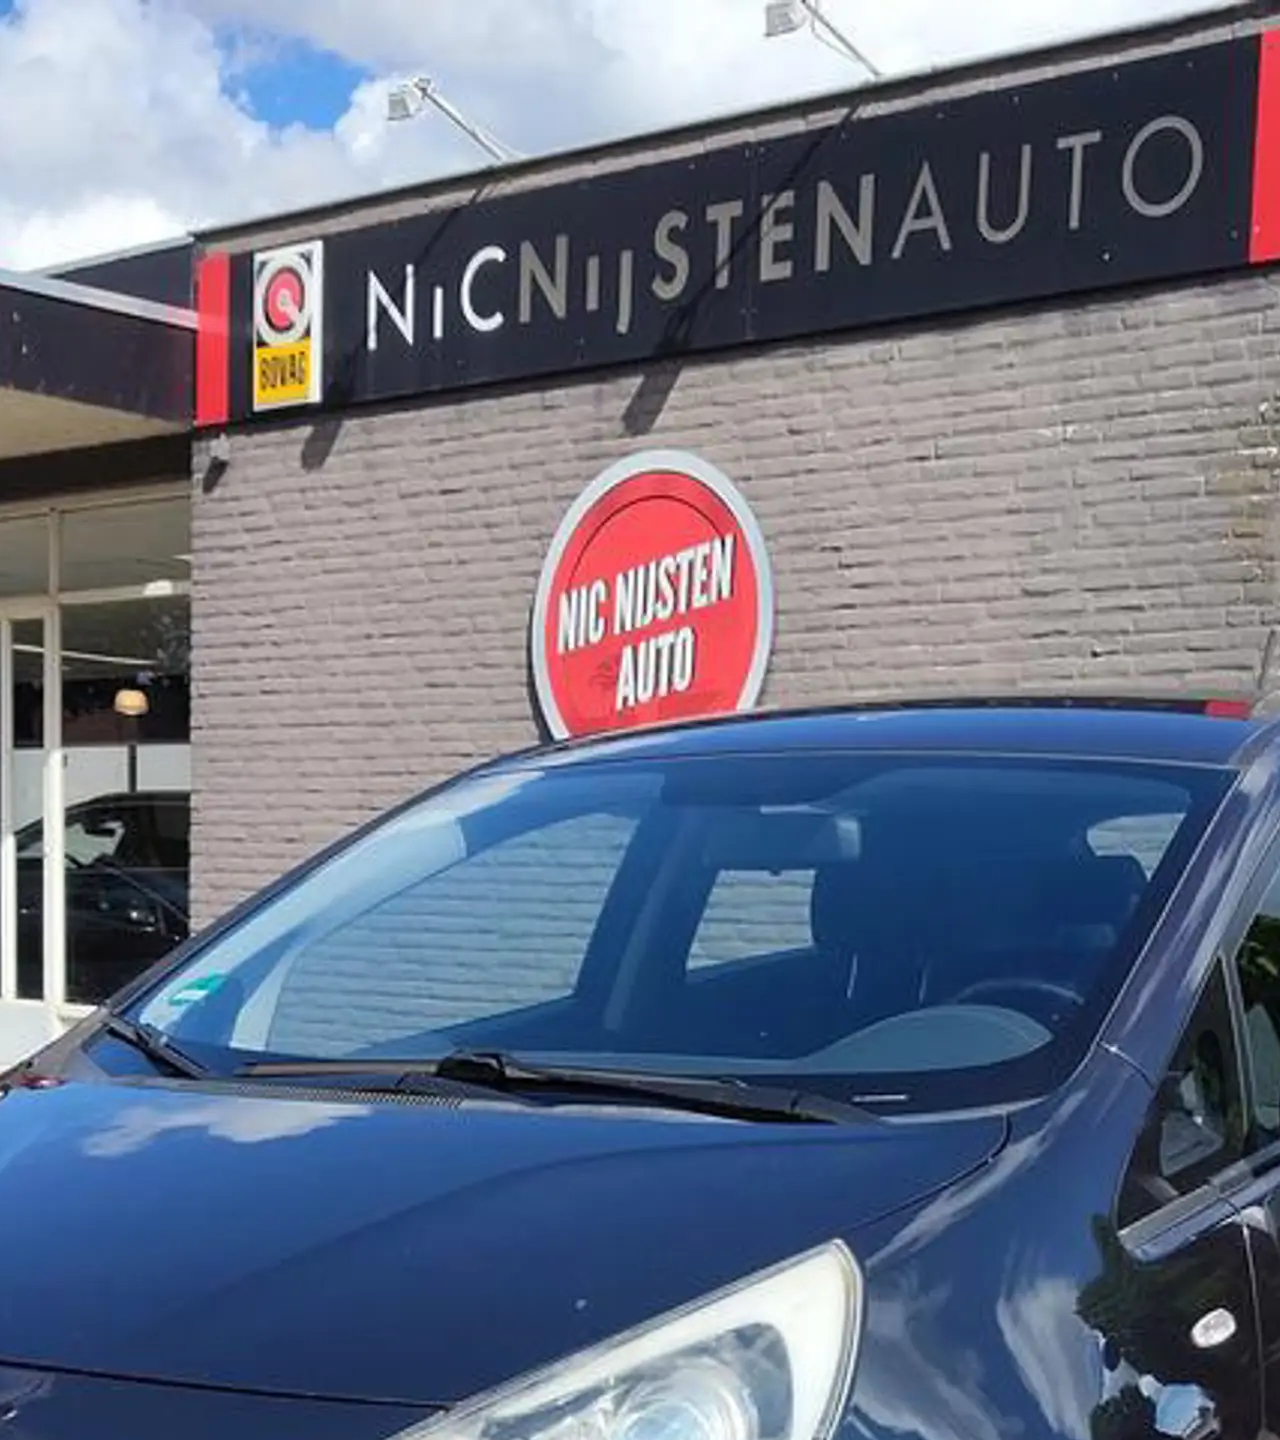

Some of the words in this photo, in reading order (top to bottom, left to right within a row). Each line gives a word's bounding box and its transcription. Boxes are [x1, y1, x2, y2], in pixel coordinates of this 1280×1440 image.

[557, 578, 608, 656] NIC
[613, 534, 736, 636] NIJSTEN
[616, 626, 694, 711] AUTO
